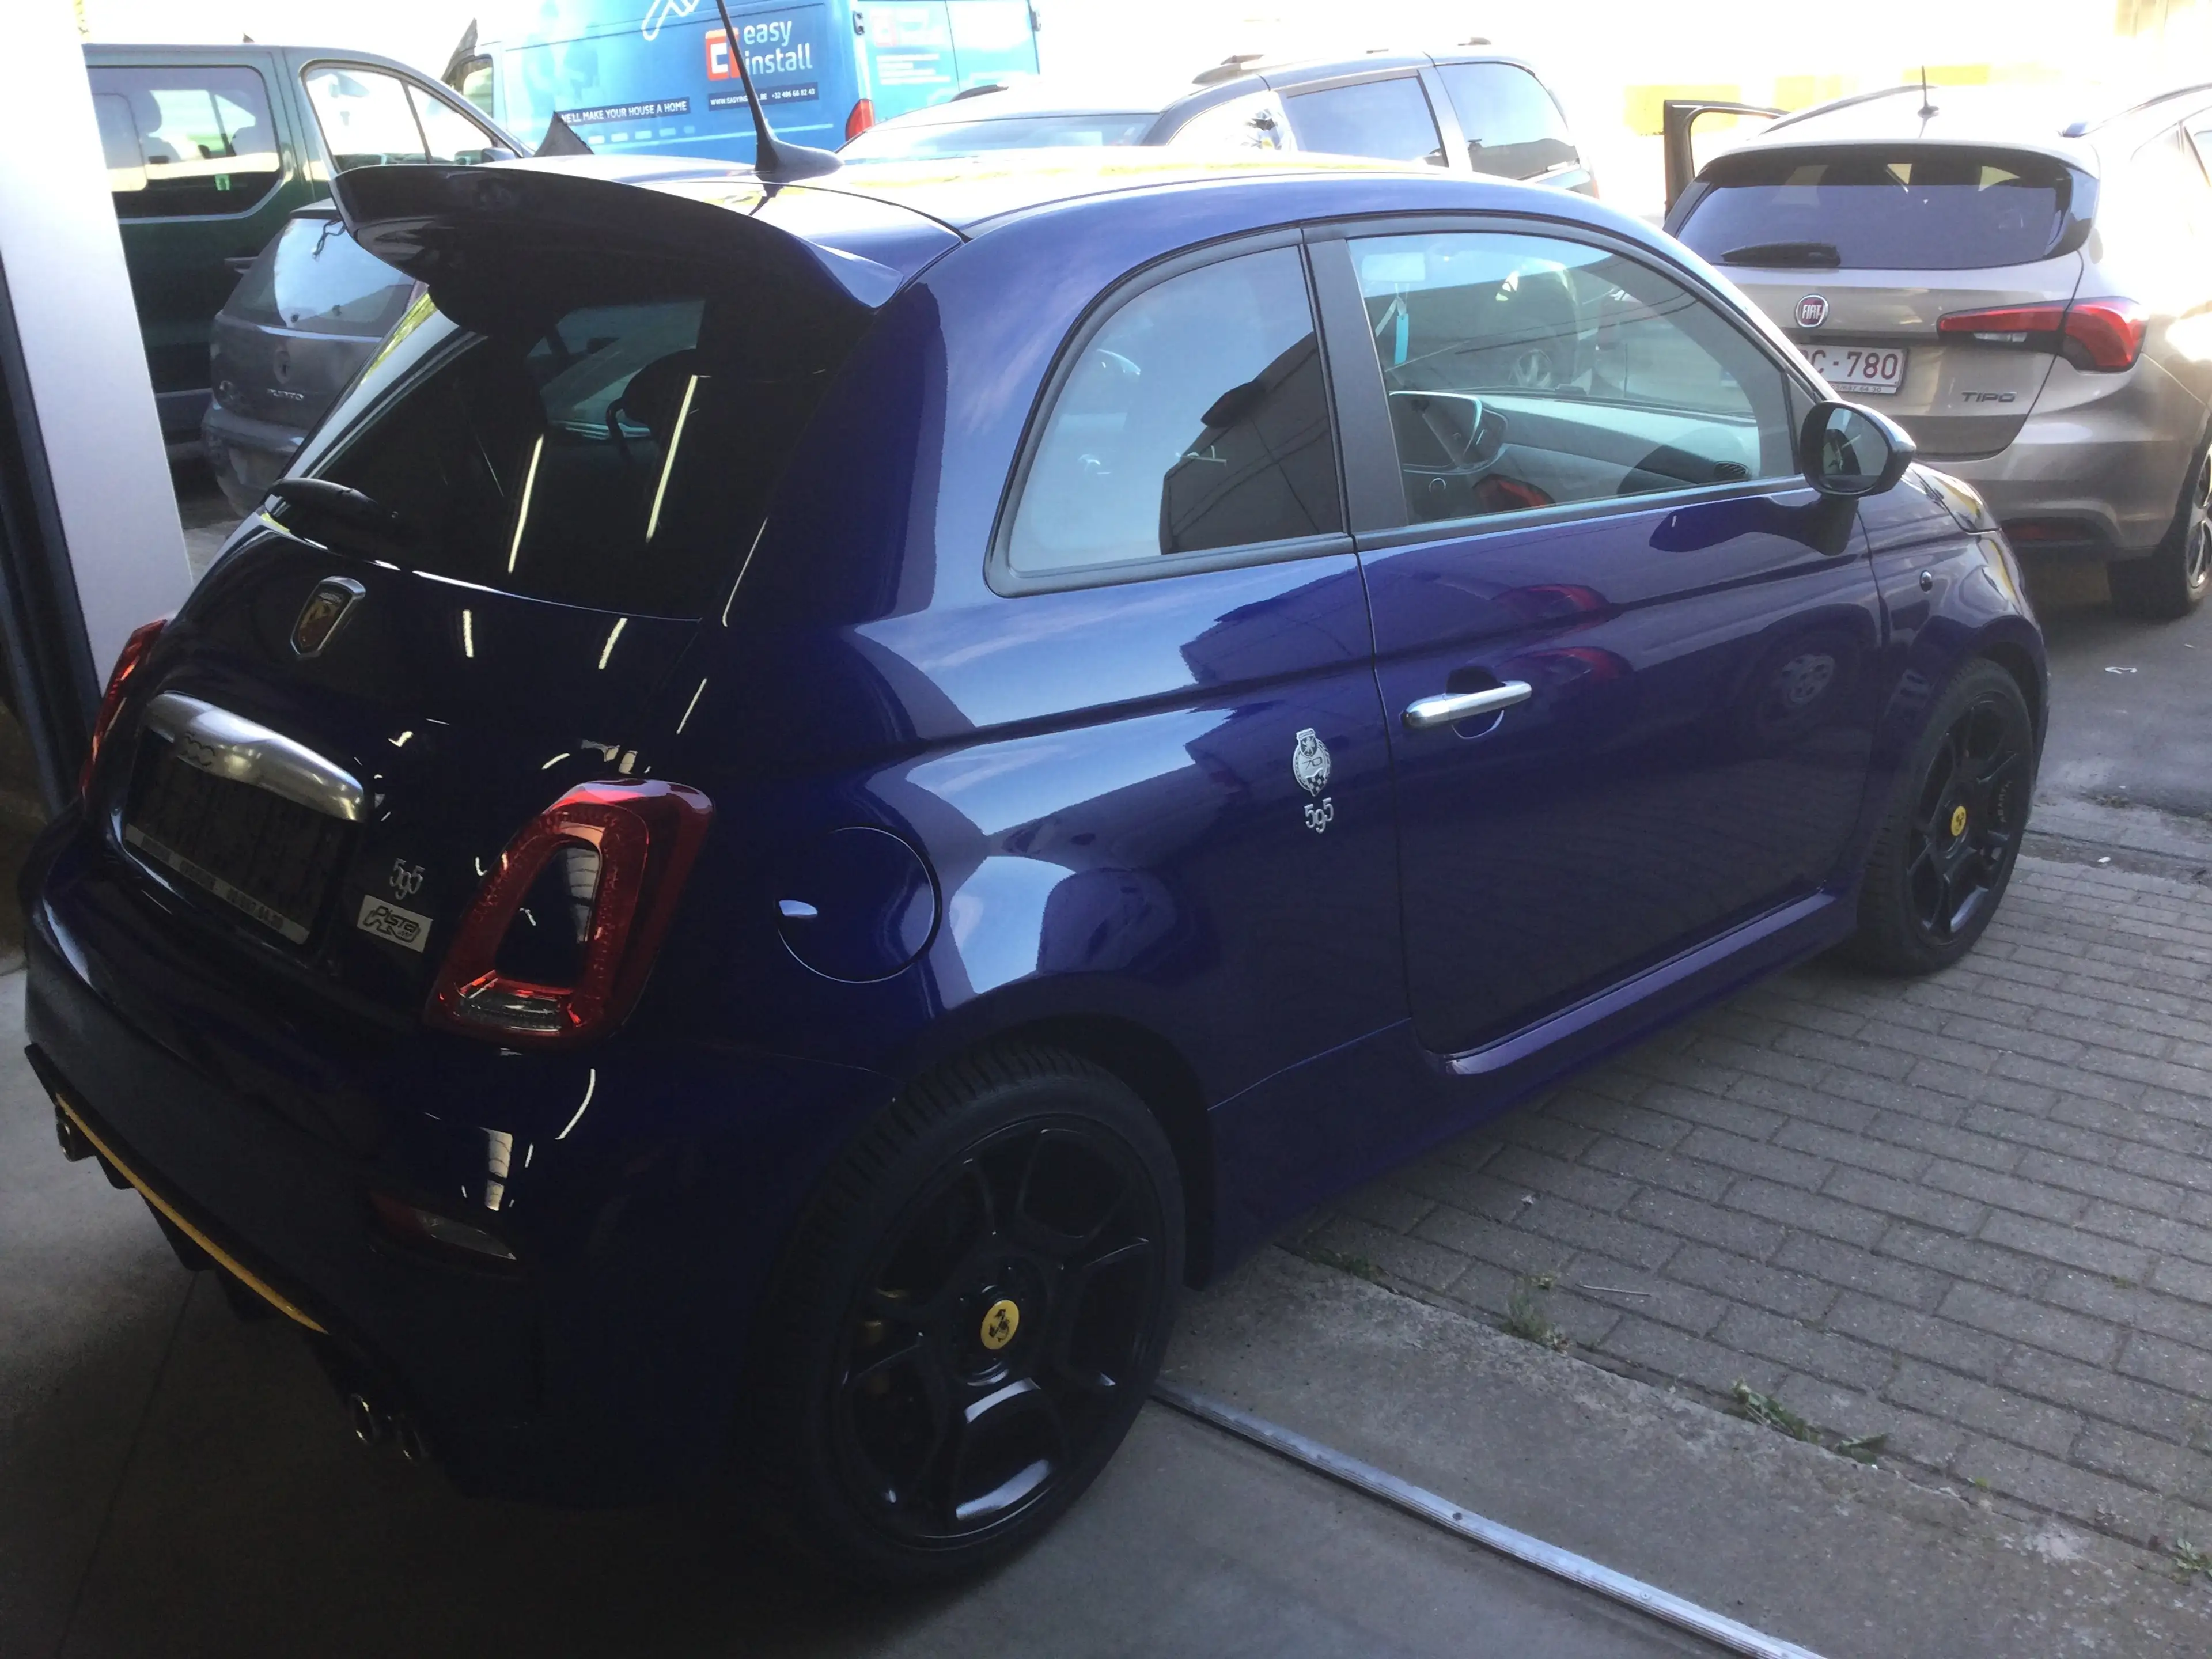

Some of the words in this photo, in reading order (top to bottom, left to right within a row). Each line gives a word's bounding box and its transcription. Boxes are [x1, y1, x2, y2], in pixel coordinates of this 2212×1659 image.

[743, 21, 793, 47] easy
[745, 43, 813, 75] install
[561, 113, 582, 123] WE'LL
[582, 109, 604, 120] MAKE
[605, 107, 627, 119] YOUR
[628, 105, 655, 116] HOUSE
[656, 104, 663, 113] A
[664, 101, 687, 112] HOME
[1802, 304, 1821, 319] FIAT
[1960, 391, 2017, 403] TIPO
[1301, 756, 1324, 770] 70
[1304, 797, 1334, 834] 595
[389, 857, 426, 901] 595
